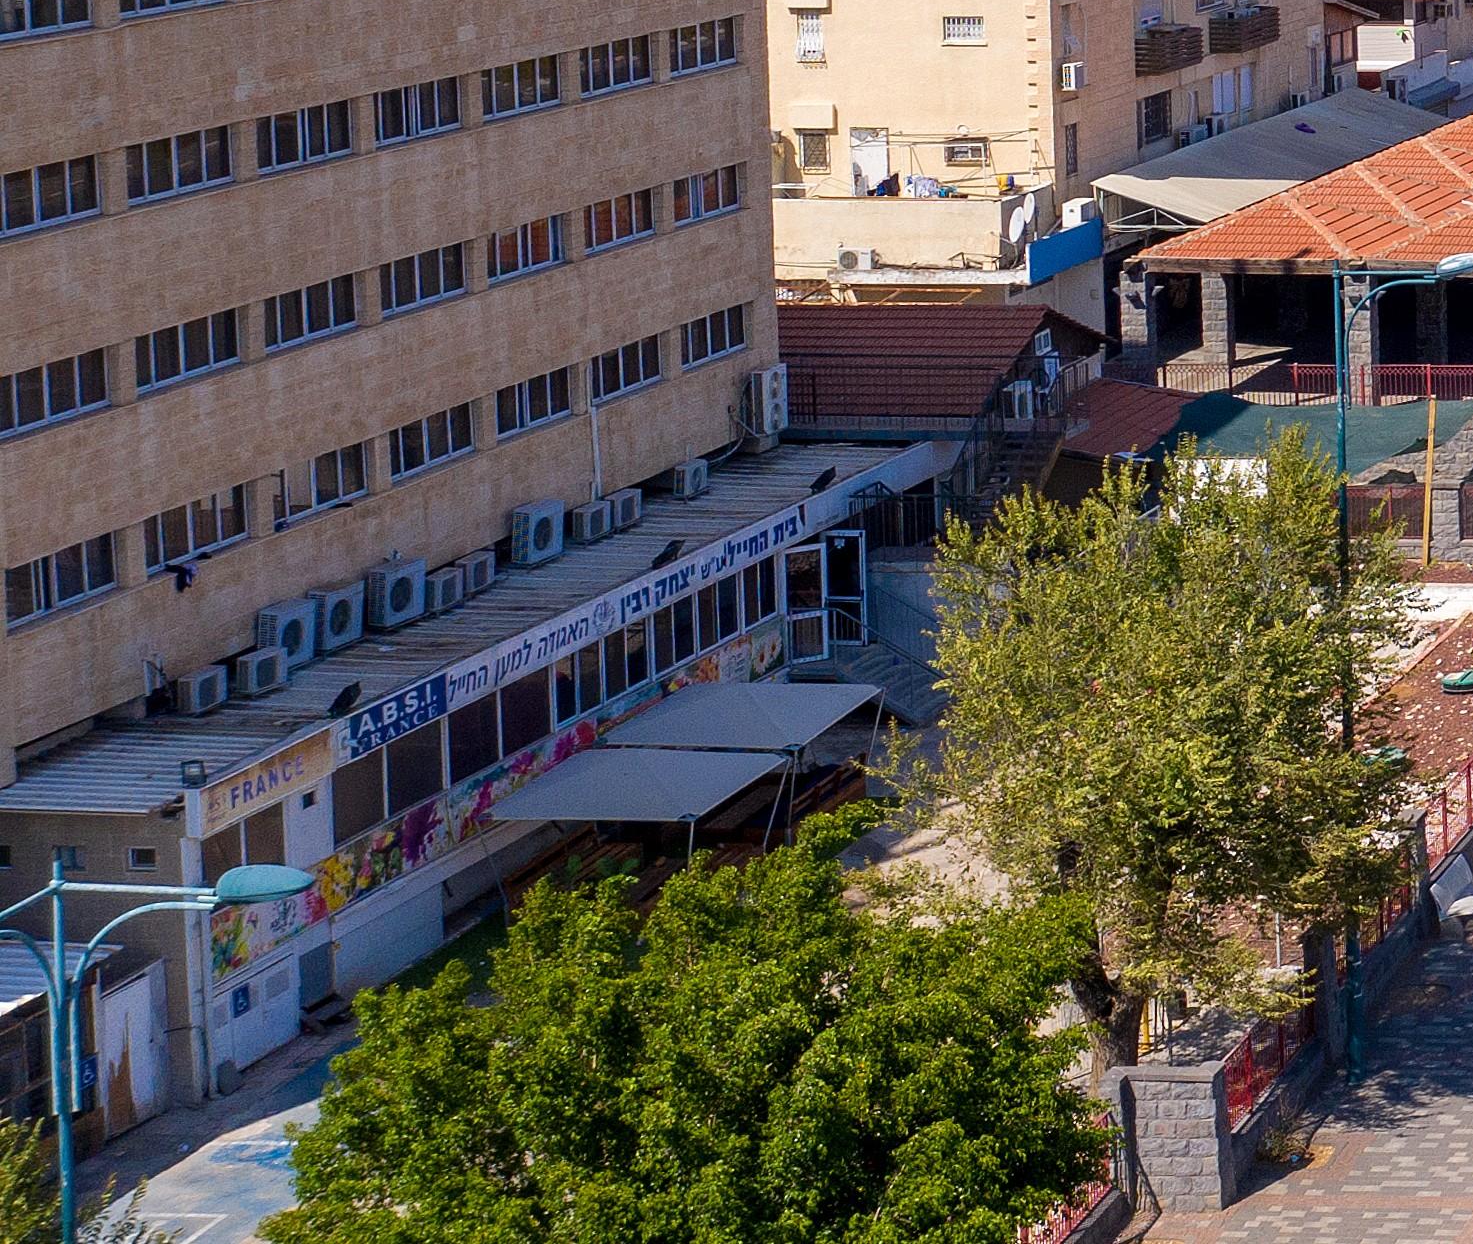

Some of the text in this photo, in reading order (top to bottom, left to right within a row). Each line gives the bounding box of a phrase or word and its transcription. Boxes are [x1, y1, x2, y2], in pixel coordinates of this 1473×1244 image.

[724, 528, 769, 567] החייל
[773, 514, 798, 546] בית
[655, 564, 696, 602] יצחק
[620, 586, 650, 624] רבין
[449, 616, 590, 703] האגודה למען החייל
[357, 683, 438, 738] A.B.S.I.
[230, 756, 304, 809] FRANCE
